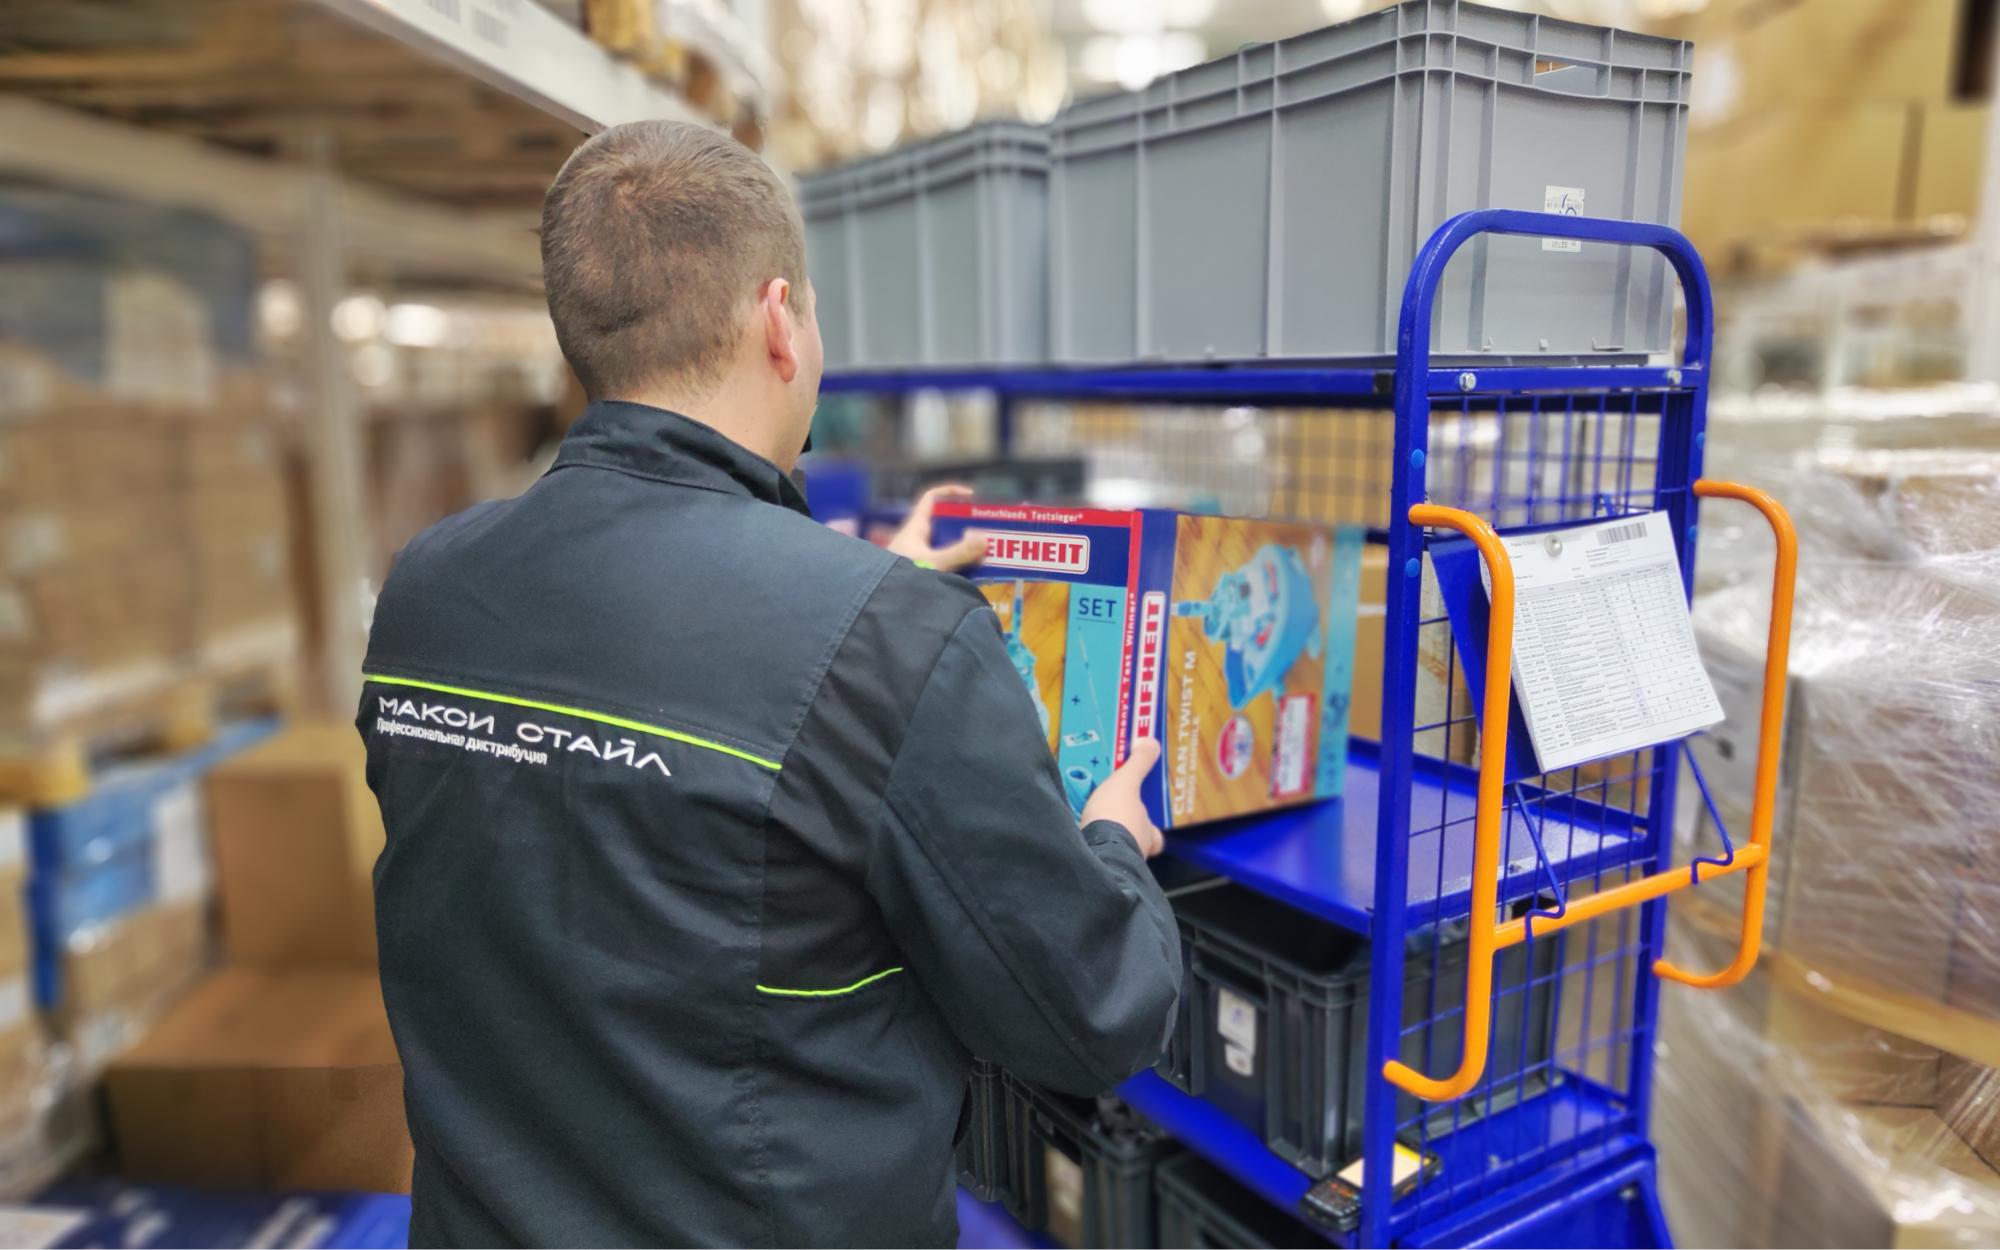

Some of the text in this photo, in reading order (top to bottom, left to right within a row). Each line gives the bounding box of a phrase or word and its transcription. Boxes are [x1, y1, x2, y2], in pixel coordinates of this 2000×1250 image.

[971, 508, 1027, 520] Deutschlands
[984, 538, 1083, 564] EIFHEIT
[1079, 597, 1117, 618] SET
[1122, 654, 1133, 684] Test
[1137, 601, 1160, 737] EIFHEIT
[377, 717, 548, 765] Профессиональная дистрибуция
[378, 696, 672, 776] МАКСИ СТАЙЛ
[1117, 691, 1129, 762] Germany's
[1174, 651, 1197, 816] CLEAN TWIST M
